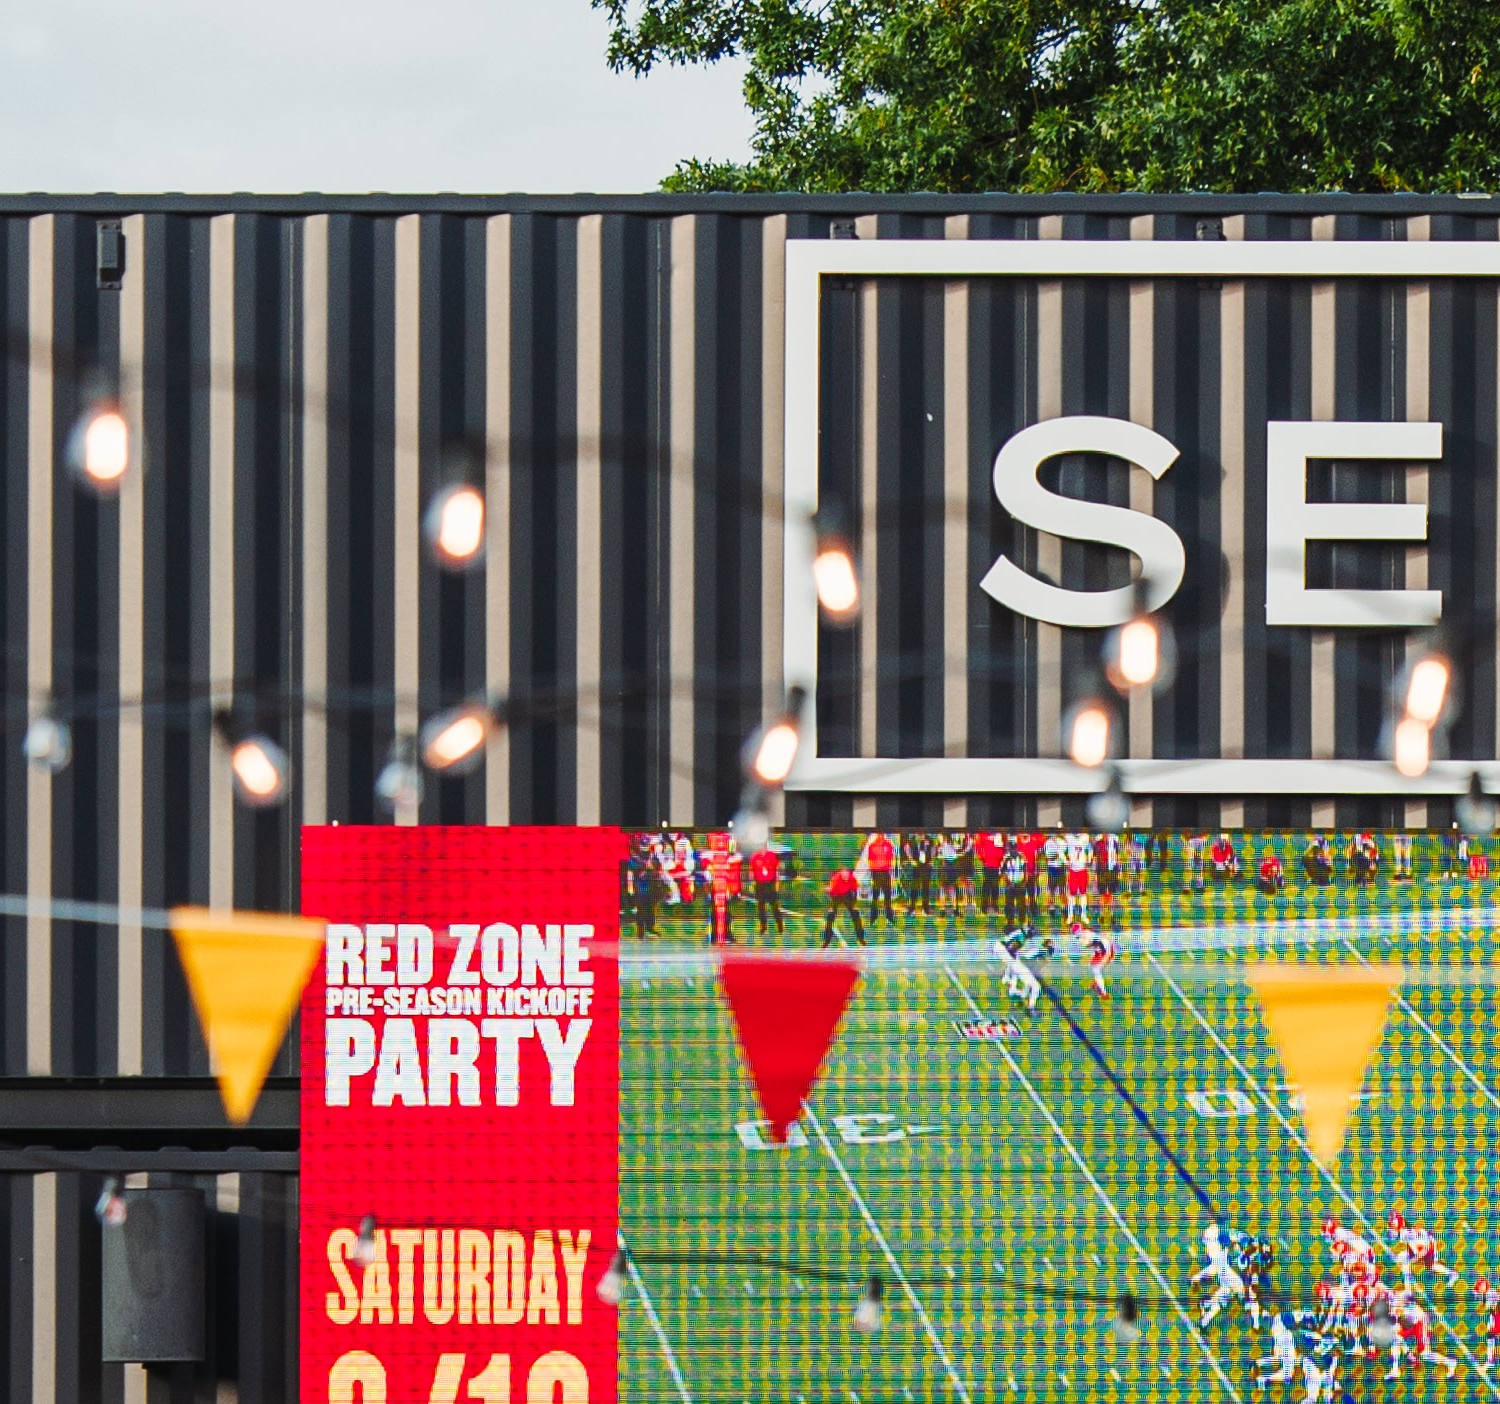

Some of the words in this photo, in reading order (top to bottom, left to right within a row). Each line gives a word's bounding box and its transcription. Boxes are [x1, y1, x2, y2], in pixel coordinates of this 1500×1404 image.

[326, 924, 433, 986] RED
[447, 923, 594, 986] ZONE
[326, 987, 483, 1016] PRE-SEASON
[487, 987, 593, 1016] KICKOFF
[326, 1018, 593, 1107] PARTY
[326, 1228, 592, 1325] SATURDAY
